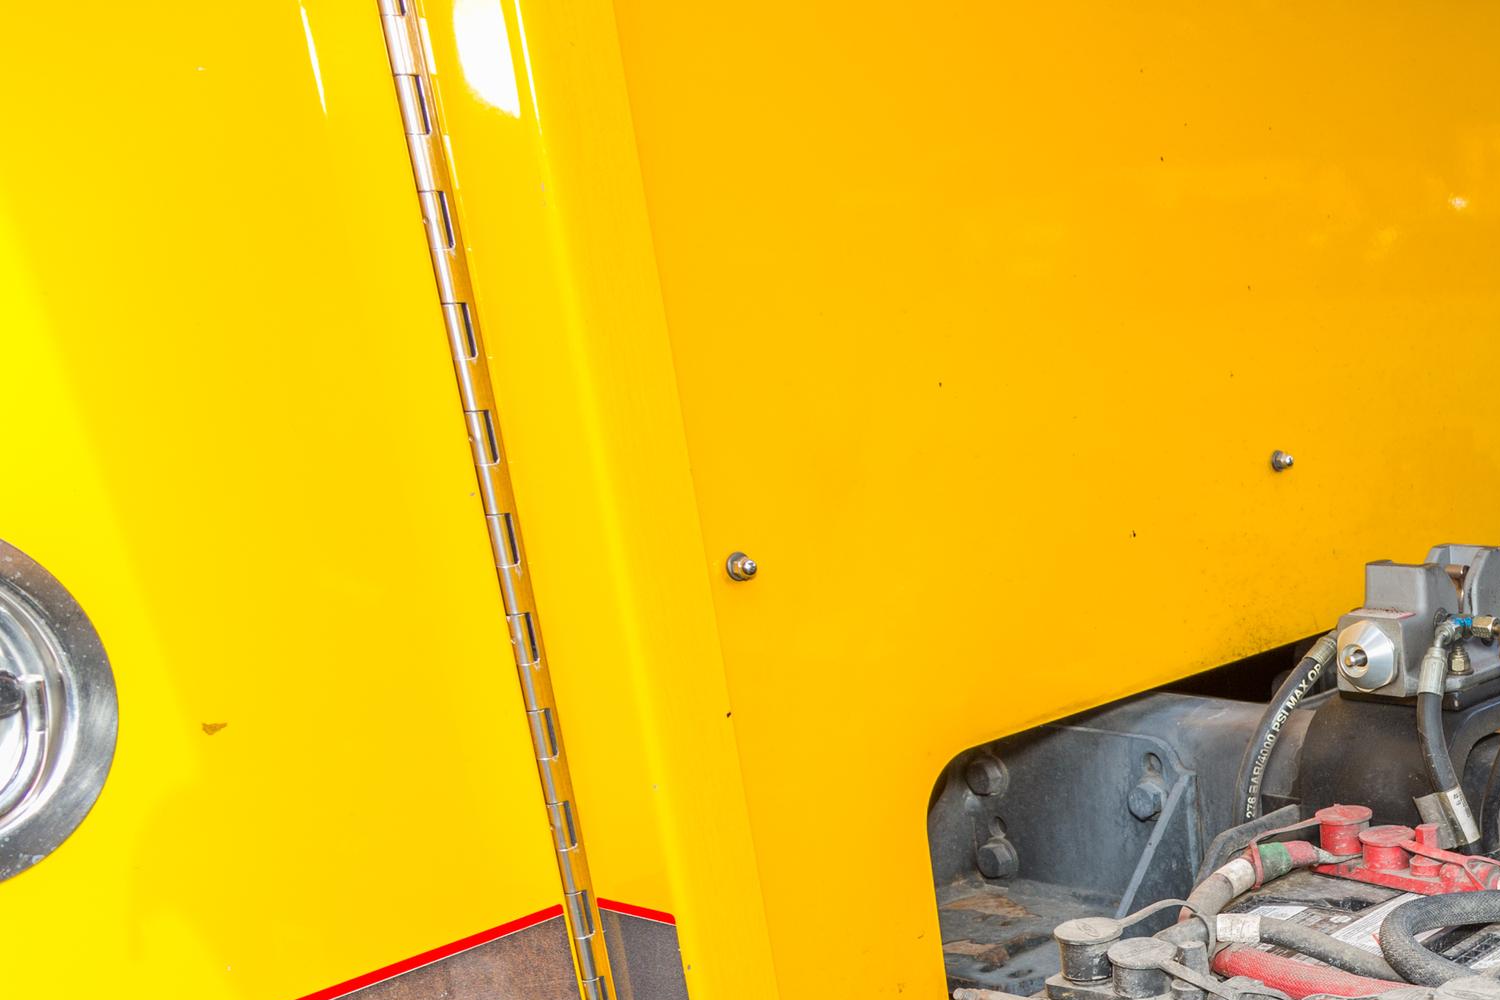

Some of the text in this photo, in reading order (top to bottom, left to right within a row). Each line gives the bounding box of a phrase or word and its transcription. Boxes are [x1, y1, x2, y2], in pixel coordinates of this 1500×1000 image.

[1246, 796, 1256, 818] 276
[1272, 708, 1290, 732] PSI
[1286, 679, 1308, 709] MAX
